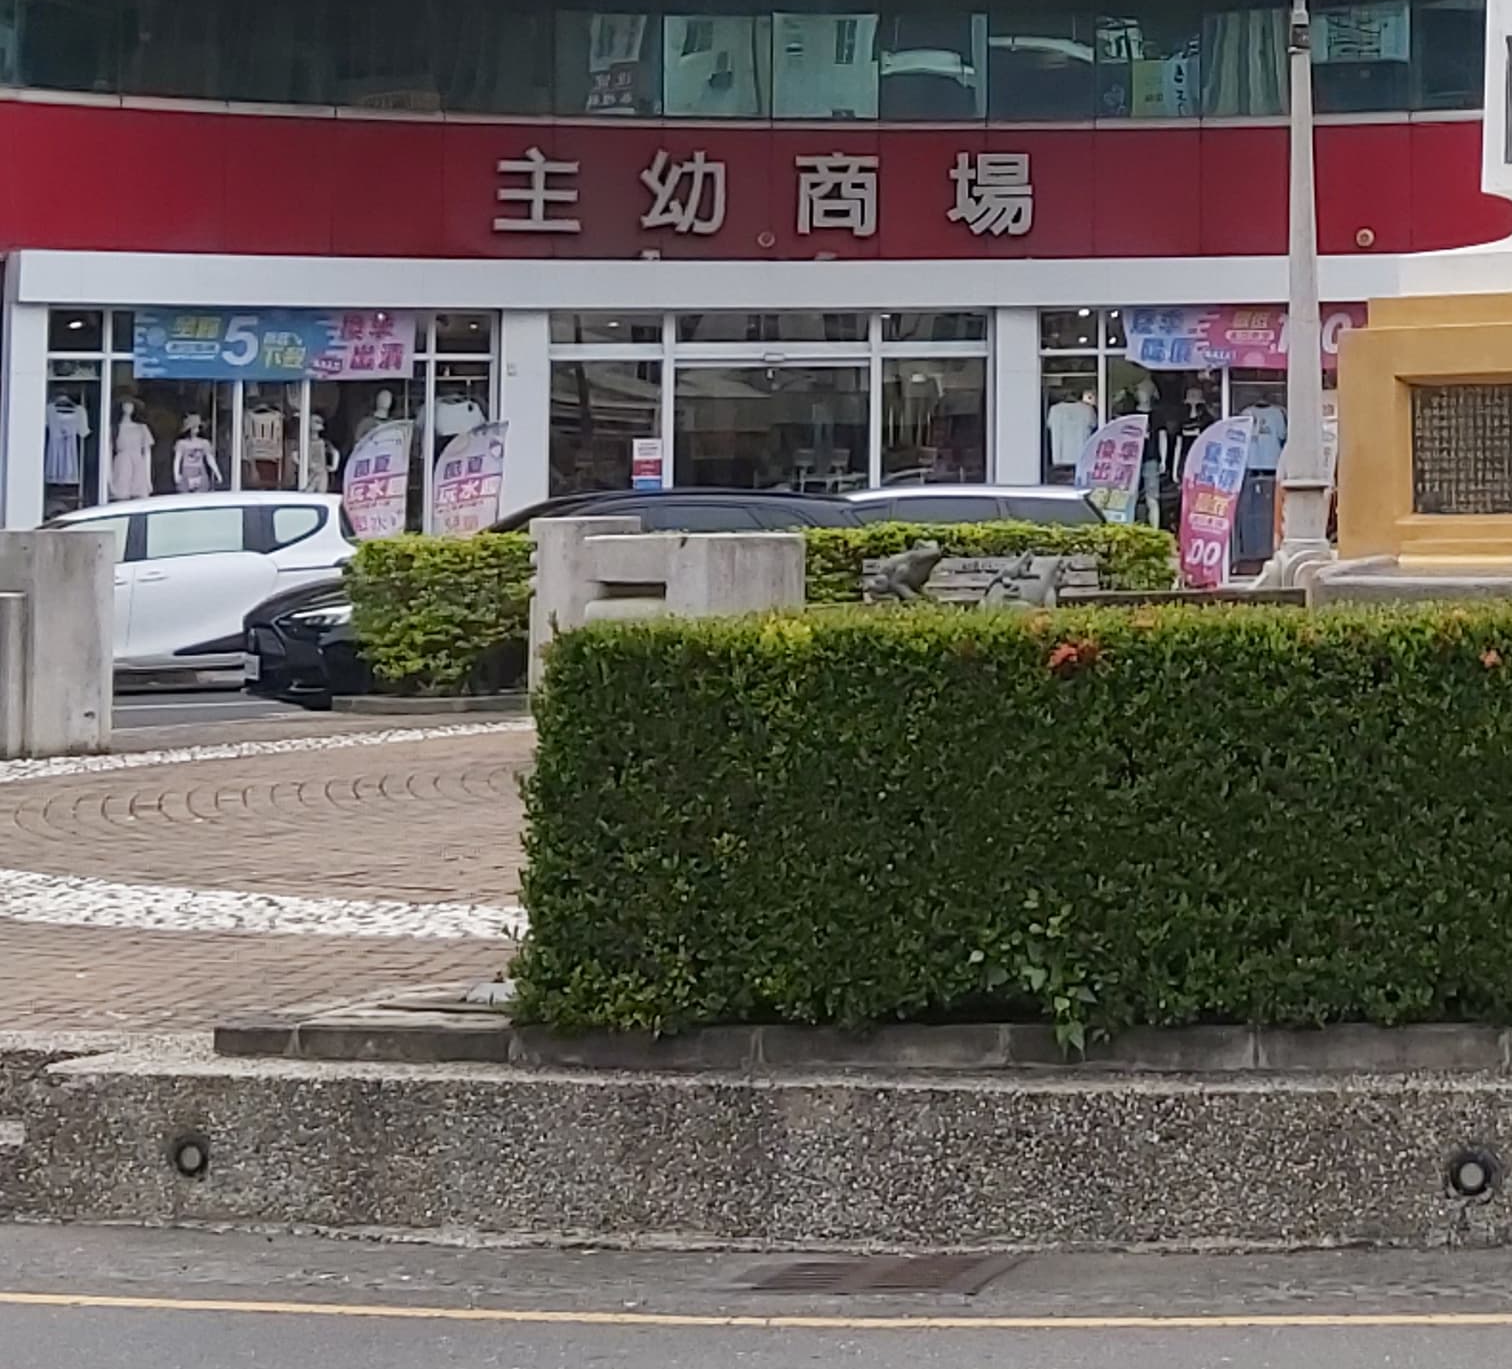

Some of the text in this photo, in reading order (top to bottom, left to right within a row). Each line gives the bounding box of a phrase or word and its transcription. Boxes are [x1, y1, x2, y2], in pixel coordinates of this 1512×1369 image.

[494, 148, 1035, 238] 主幼商場
[222, 316, 259, 366] 5
